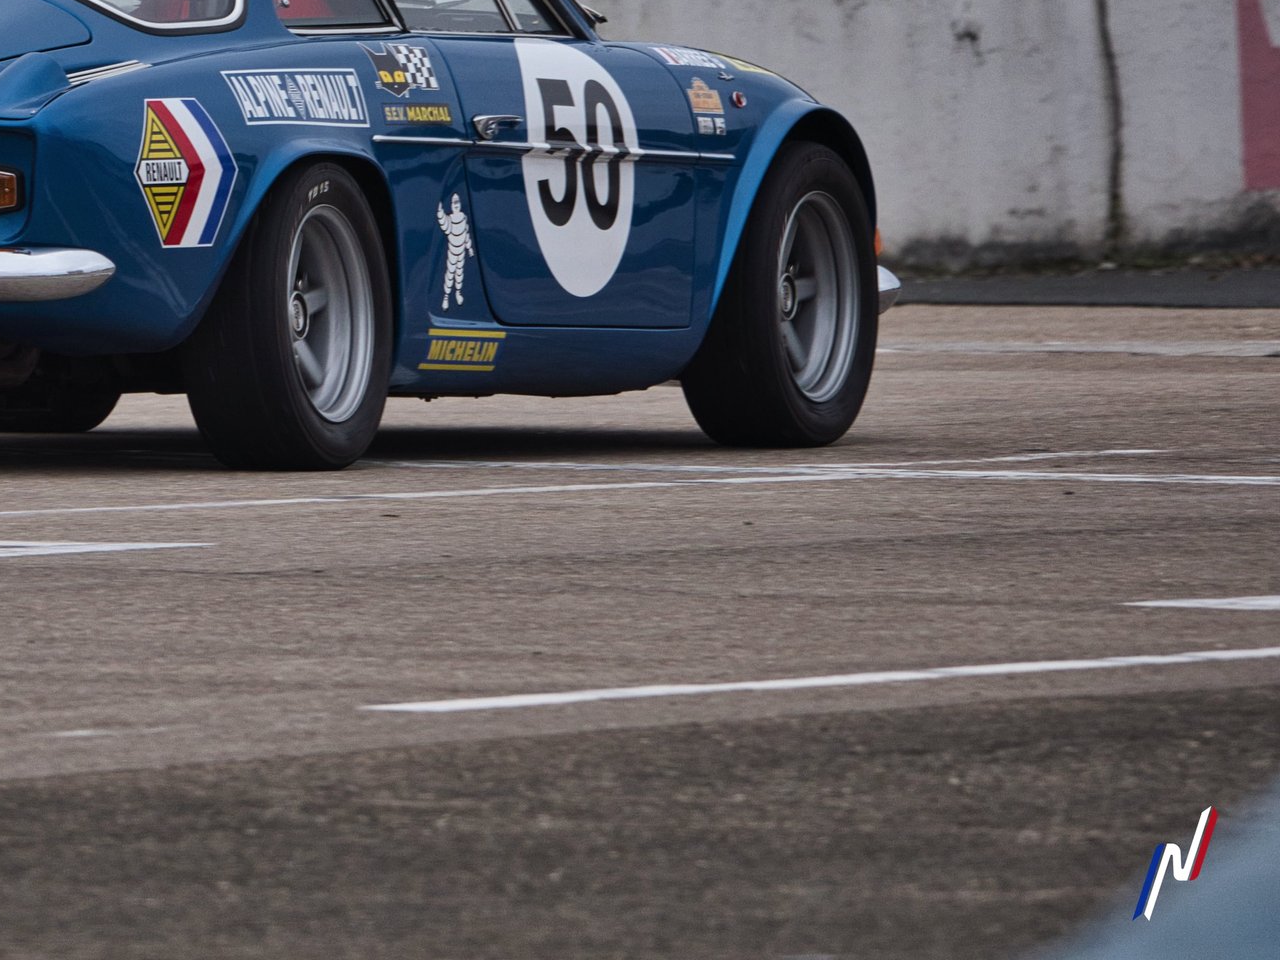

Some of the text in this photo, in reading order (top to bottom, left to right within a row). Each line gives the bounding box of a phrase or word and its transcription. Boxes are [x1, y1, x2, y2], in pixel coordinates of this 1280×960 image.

[230, 74, 364, 120] ALPINE RENAULT
[406, 106, 451, 121] MARCHAL
[536, 77, 626, 231] 50
[145, 161, 182, 182] RENAULT
[427, 339, 499, 362] MICHELIN
